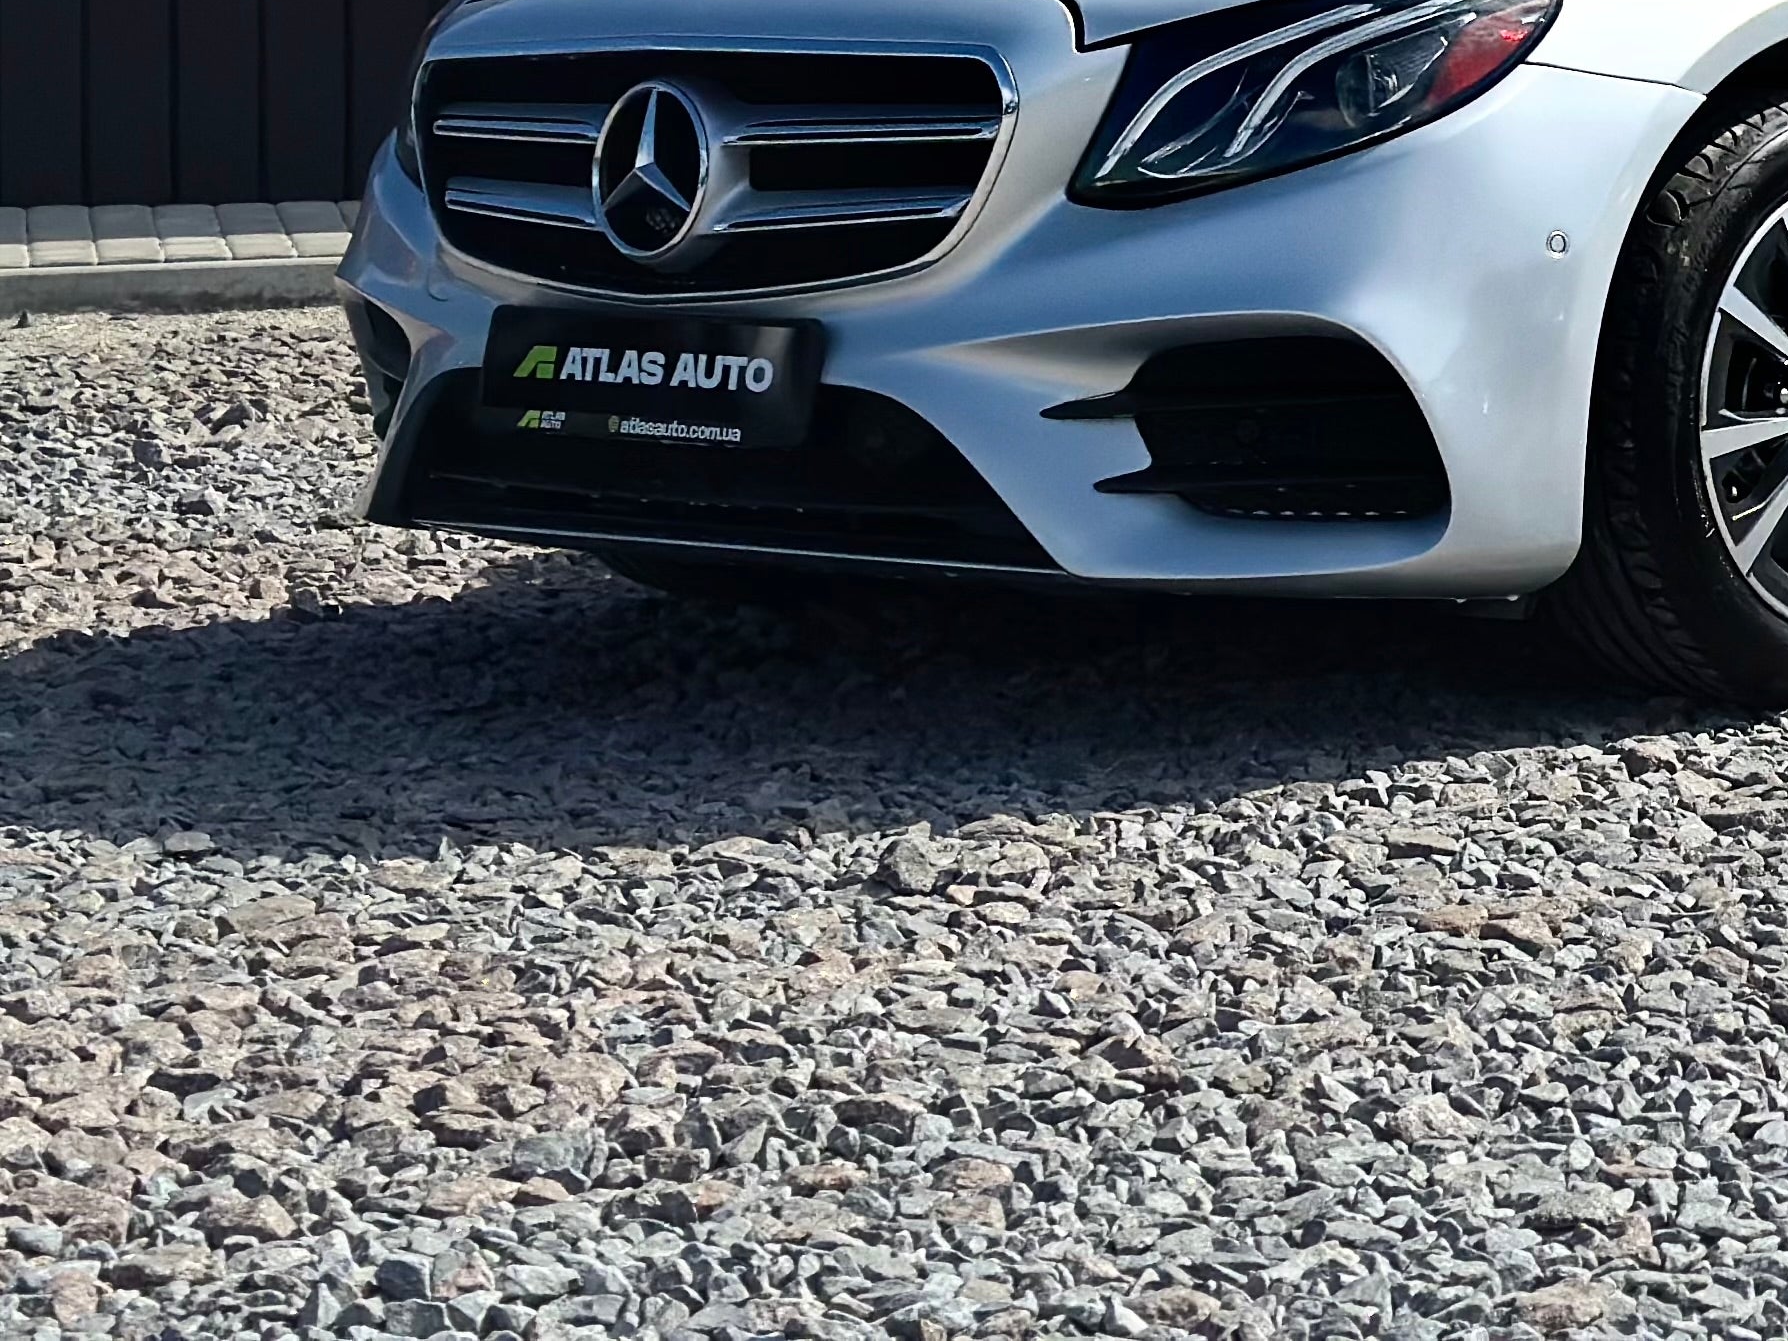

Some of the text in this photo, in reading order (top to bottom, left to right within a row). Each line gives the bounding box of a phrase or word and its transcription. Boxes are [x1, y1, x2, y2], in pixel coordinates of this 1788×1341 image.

[559, 347, 773, 392] ATLAS AUTO
[619, 418, 741, 442] atlasauto.com.ua
